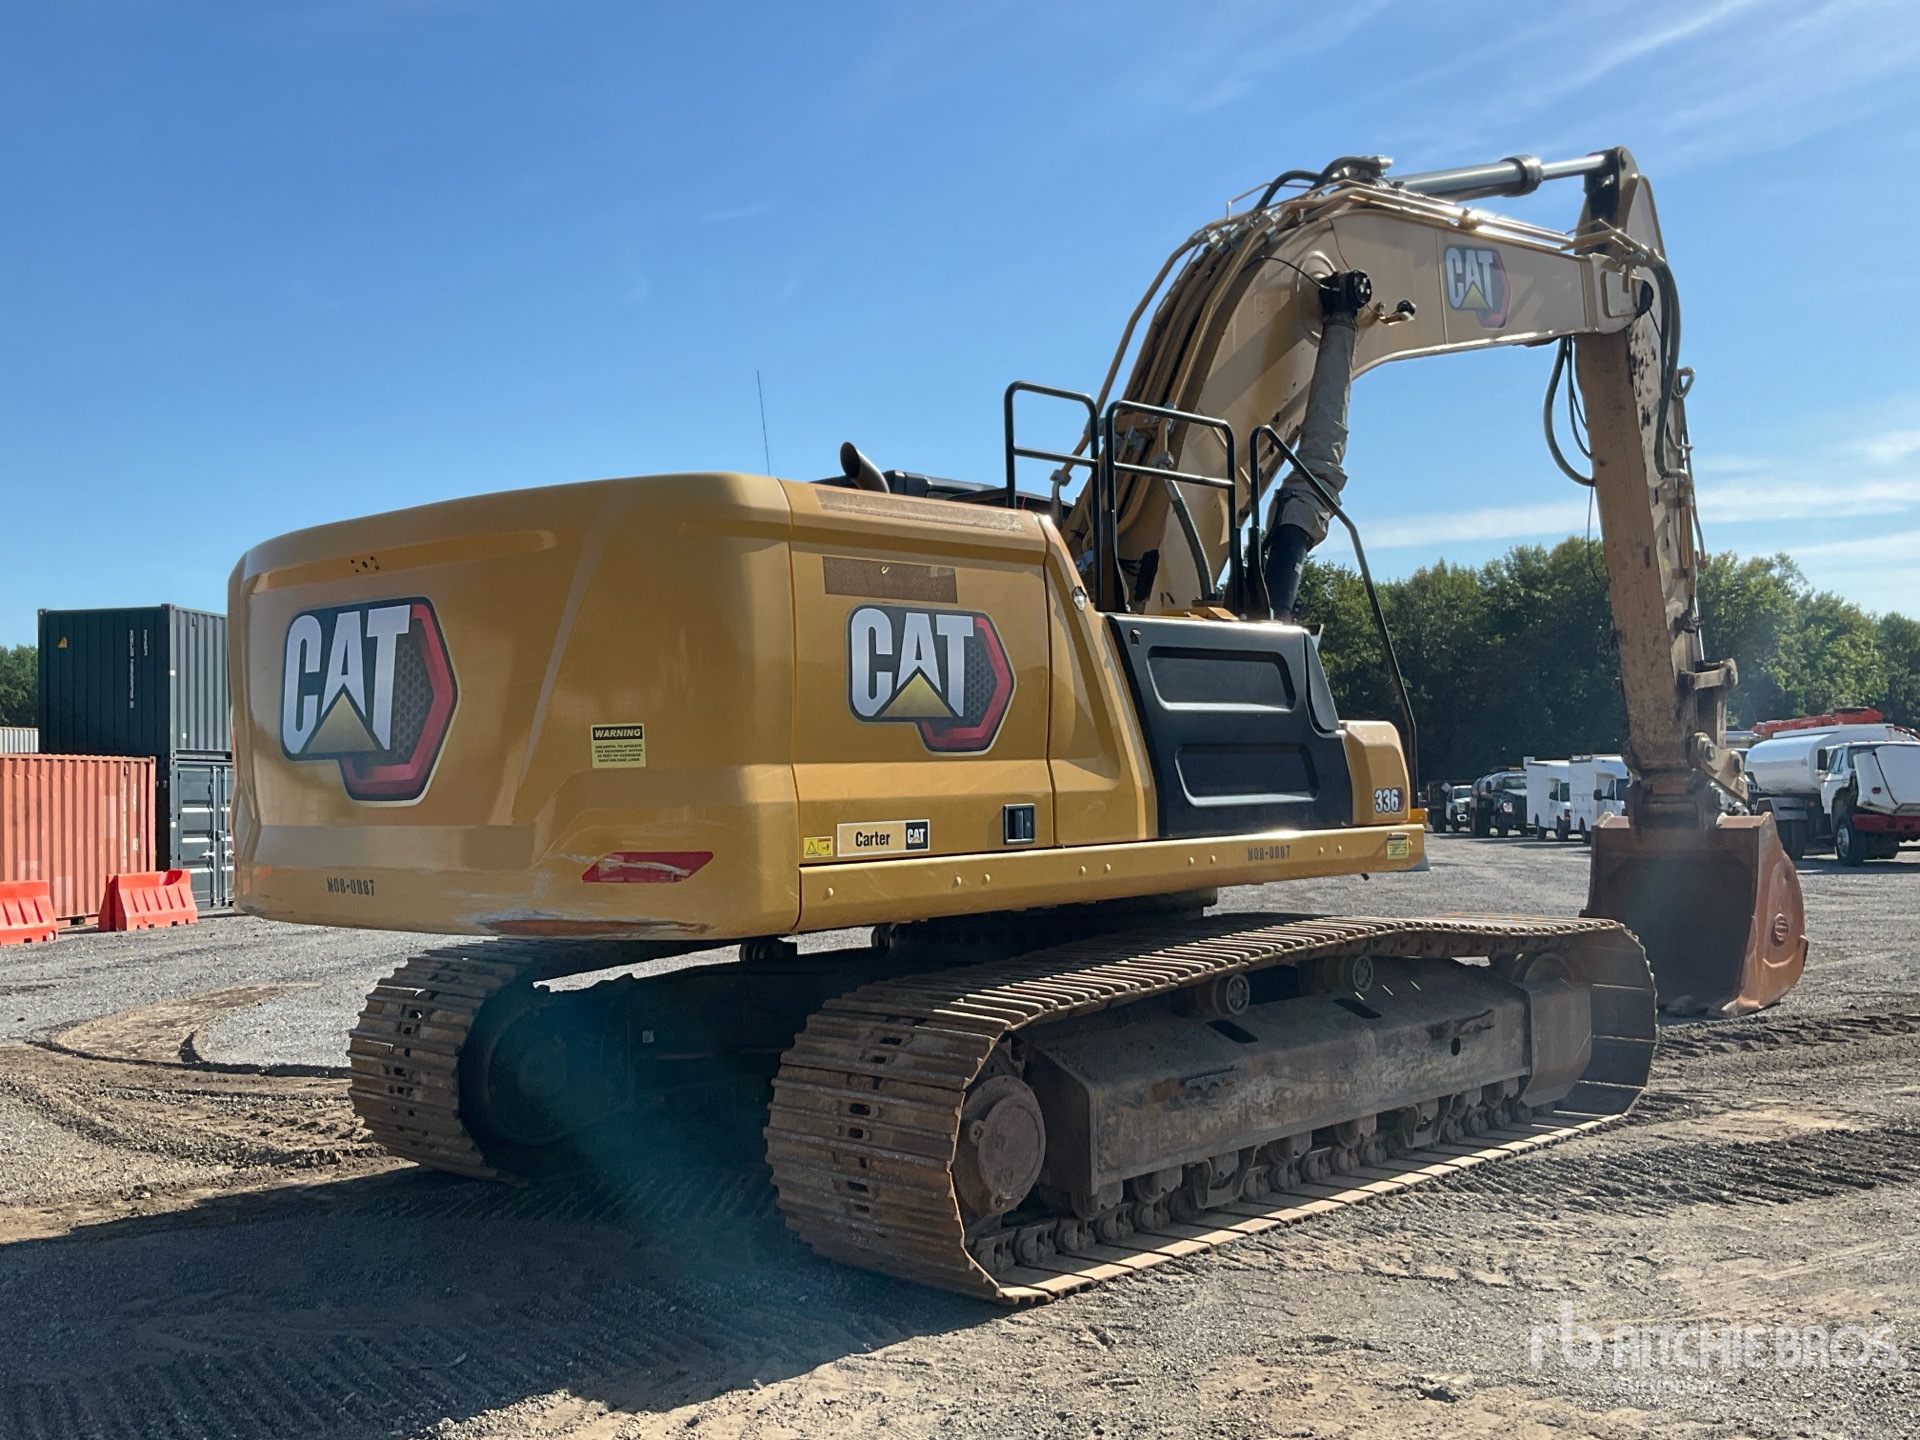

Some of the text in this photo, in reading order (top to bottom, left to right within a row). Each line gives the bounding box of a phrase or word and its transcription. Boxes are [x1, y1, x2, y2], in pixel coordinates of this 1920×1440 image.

[1446, 247, 1493, 308] CAT
[851, 608, 974, 717] CAT
[283, 605, 411, 753] CAT
[595, 729, 641, 738] WARNING
[1375, 789, 1399, 812] 336
[855, 831, 891, 847] Carter
[907, 828, 925, 844] CAT
